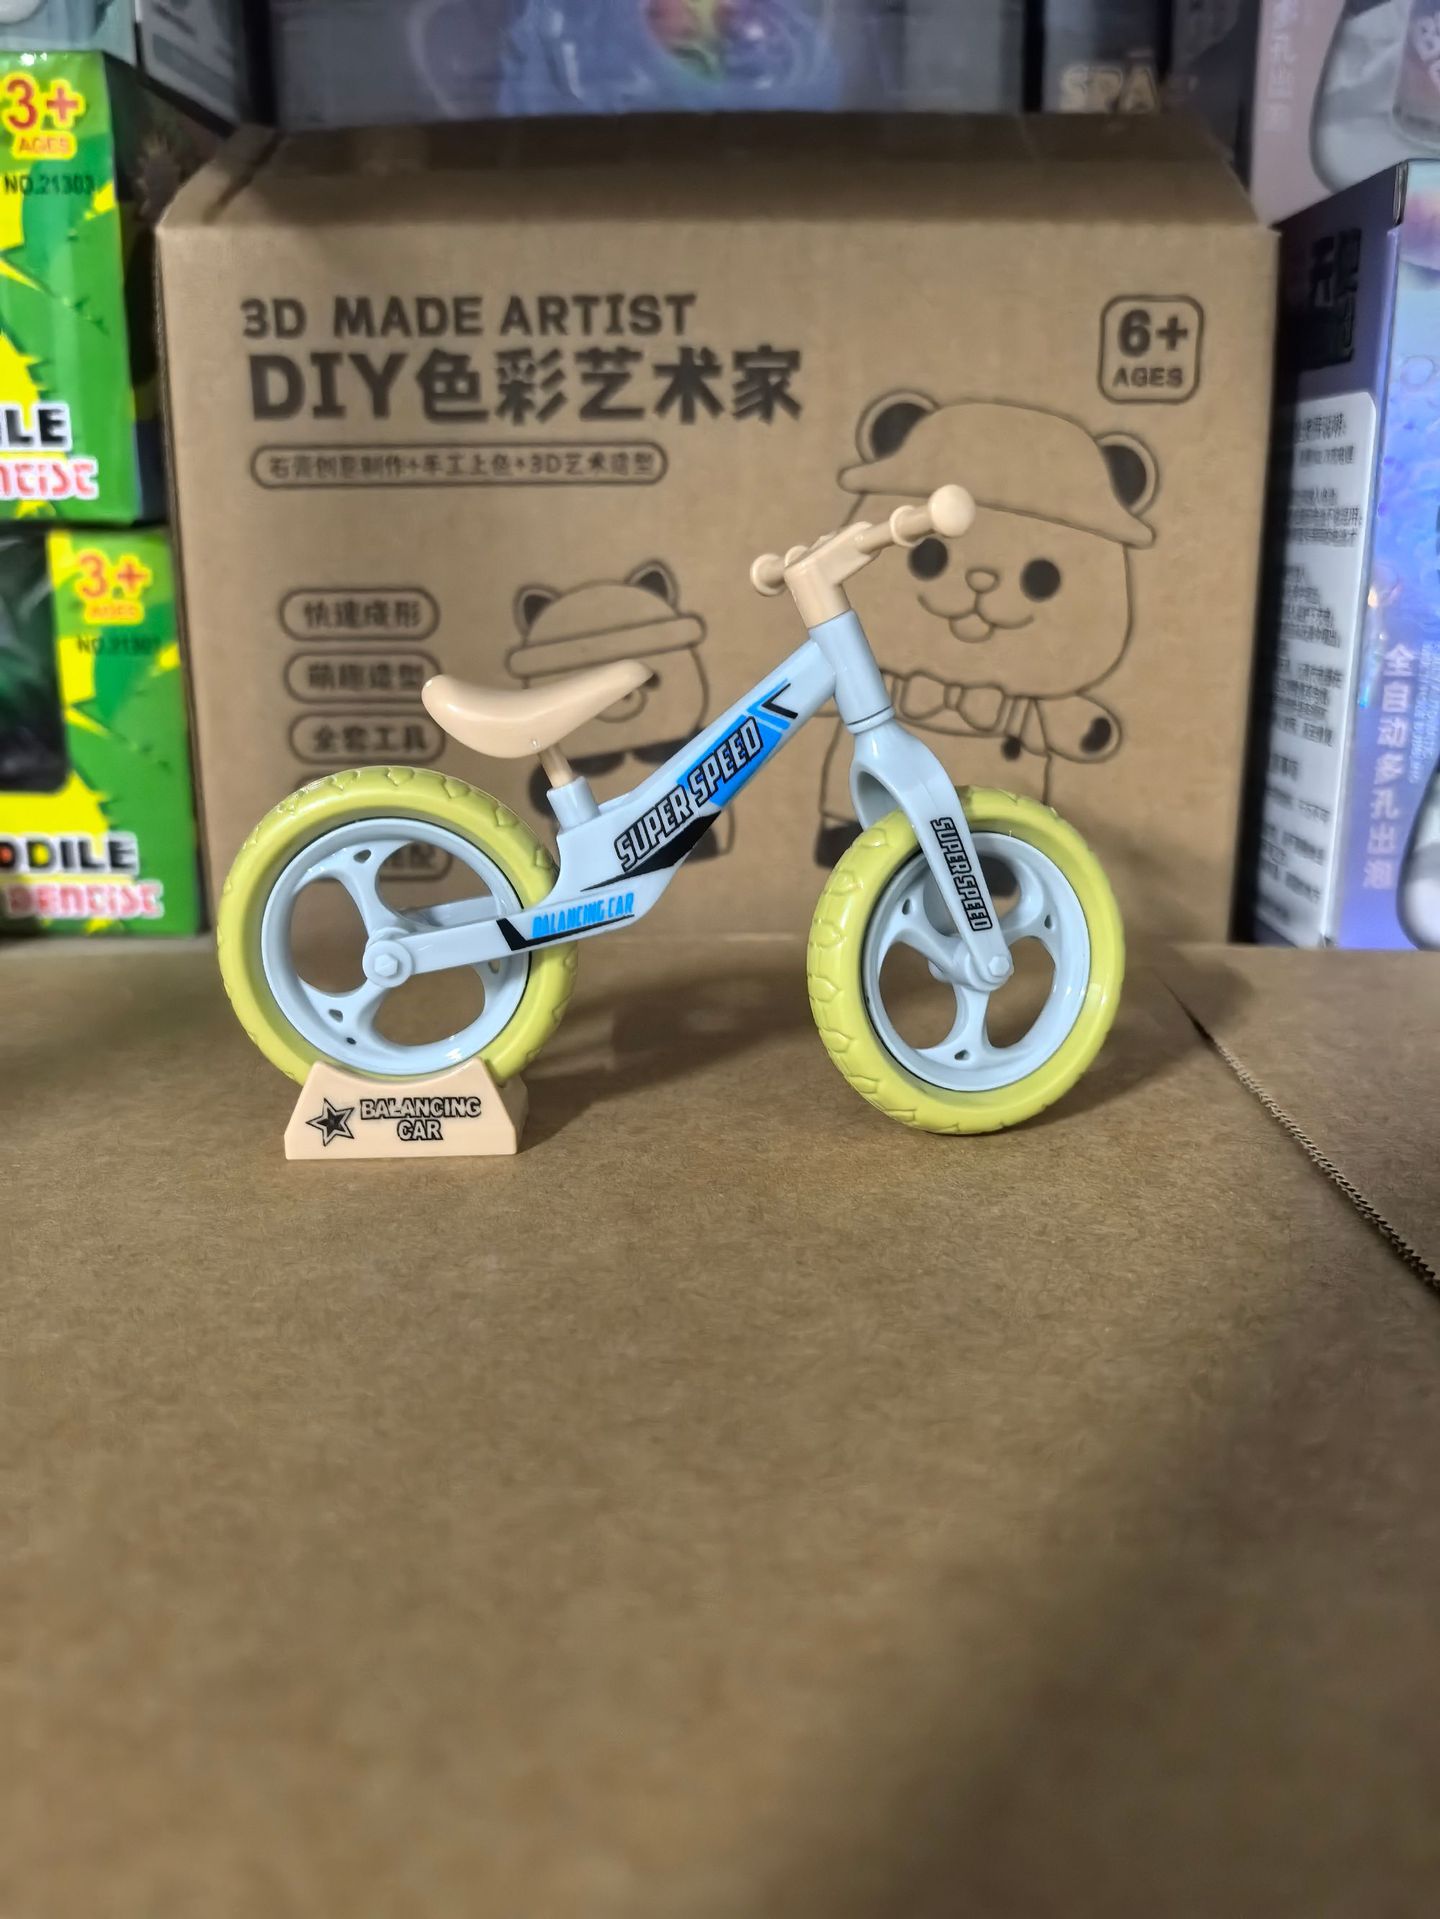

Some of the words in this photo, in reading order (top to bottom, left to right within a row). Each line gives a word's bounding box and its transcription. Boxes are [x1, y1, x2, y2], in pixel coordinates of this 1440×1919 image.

[6, 78, 80, 130] 3+
[242, 298, 306, 339] 3D
[333, 295, 484, 338] MADE
[500, 292, 697, 337] ARTIST
[1117, 308, 1188, 358] 6+
[248, 344, 803, 425] DIY色彩艺术家
[1112, 366, 1183, 388] AGES
[0, 408, 67, 447] LE
[79, 555, 149, 598] 3+
[614, 785, 694, 873] SUPER
[687, 716, 764, 807] SPEED
[930, 817, 972, 875] SUPER
[953, 875, 993, 932] SPEED
[606, 892, 634, 919] CAR
[360, 1097, 482, 1120] BALANCING
[397, 1118, 444, 1141] CAR
